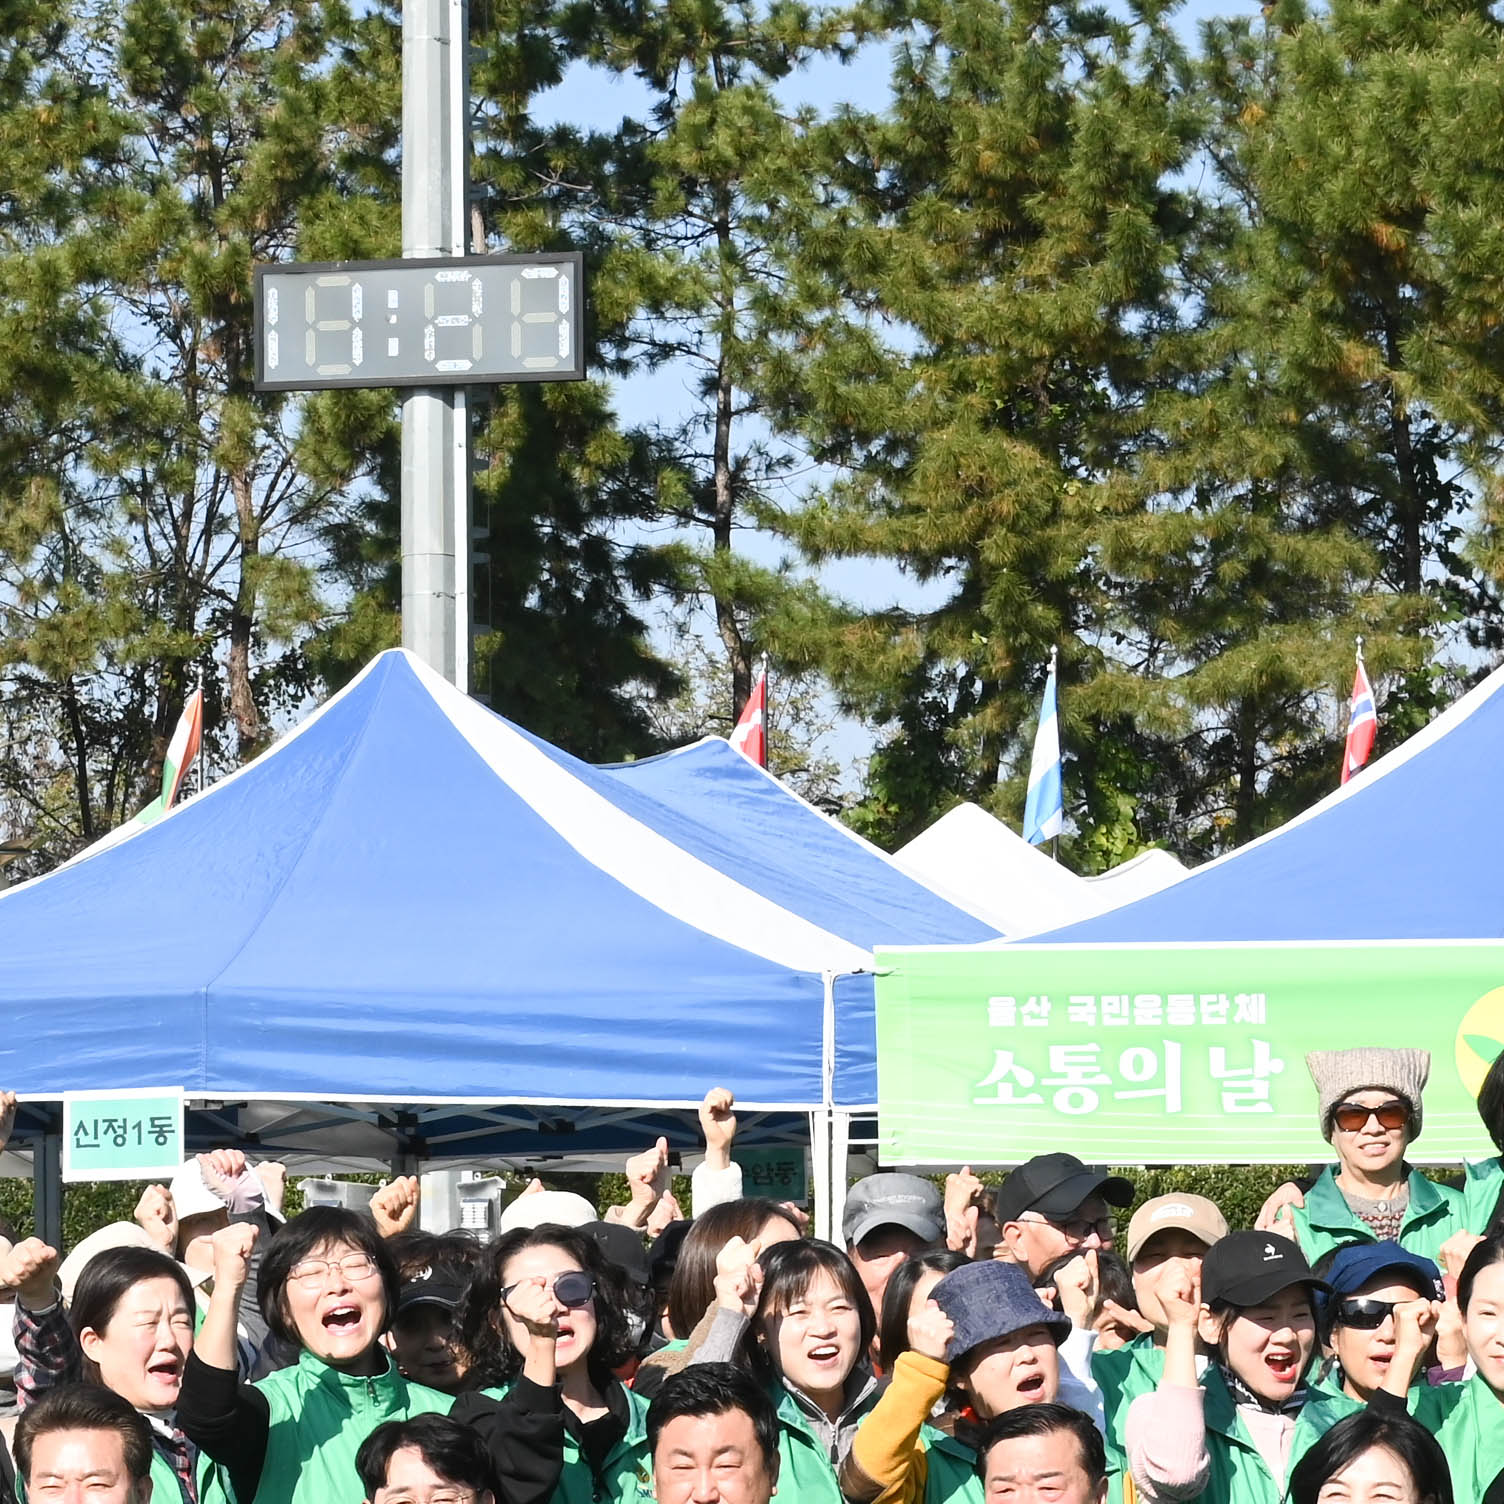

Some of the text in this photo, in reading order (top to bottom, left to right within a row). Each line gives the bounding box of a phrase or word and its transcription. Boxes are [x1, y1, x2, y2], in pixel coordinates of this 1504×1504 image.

[267, 267, 569, 371] 11:27
[987, 993, 1267, 1027] 울산 국민운동단체
[973, 1039, 1285, 1115] 소통의 날
[73, 1114, 176, 1150] 신정1동
